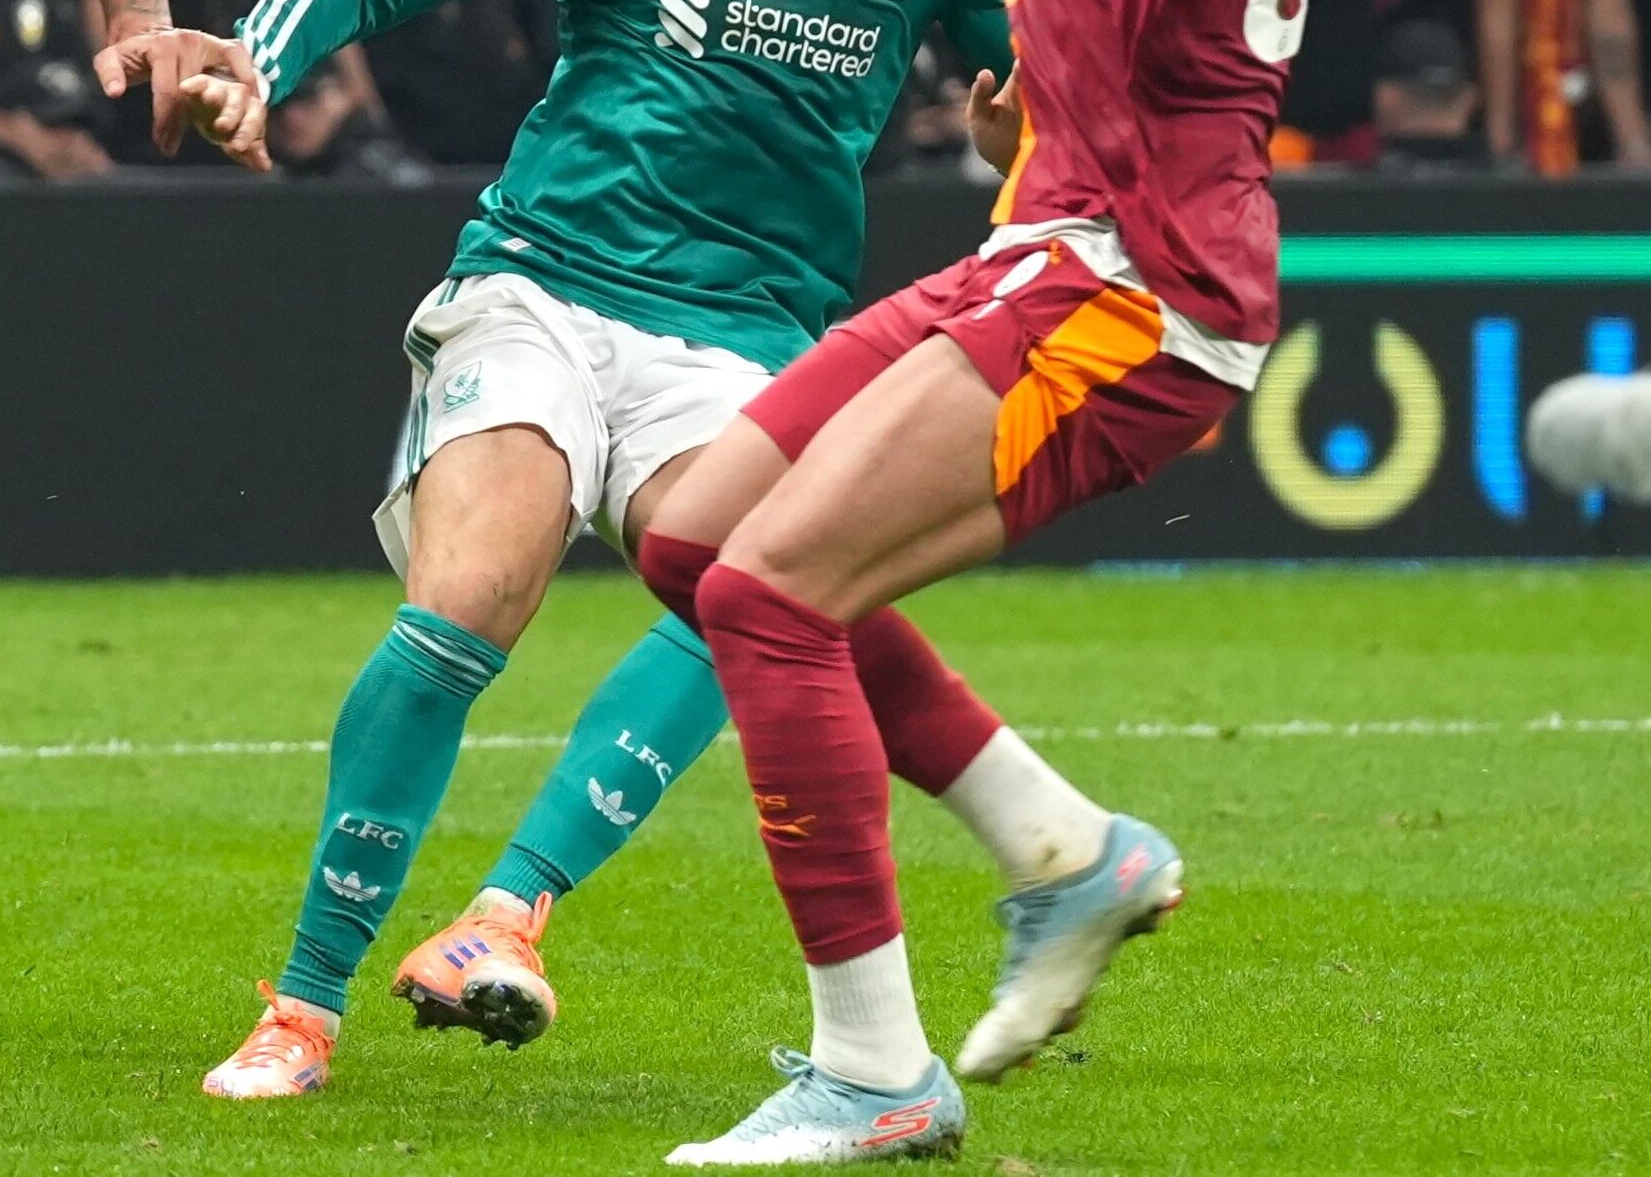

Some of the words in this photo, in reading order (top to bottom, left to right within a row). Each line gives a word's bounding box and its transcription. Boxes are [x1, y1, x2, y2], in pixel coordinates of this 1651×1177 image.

[720, 27, 876, 78] chartered
[614, 729, 673, 789] LFC
[335, 812, 404, 850] LFC
